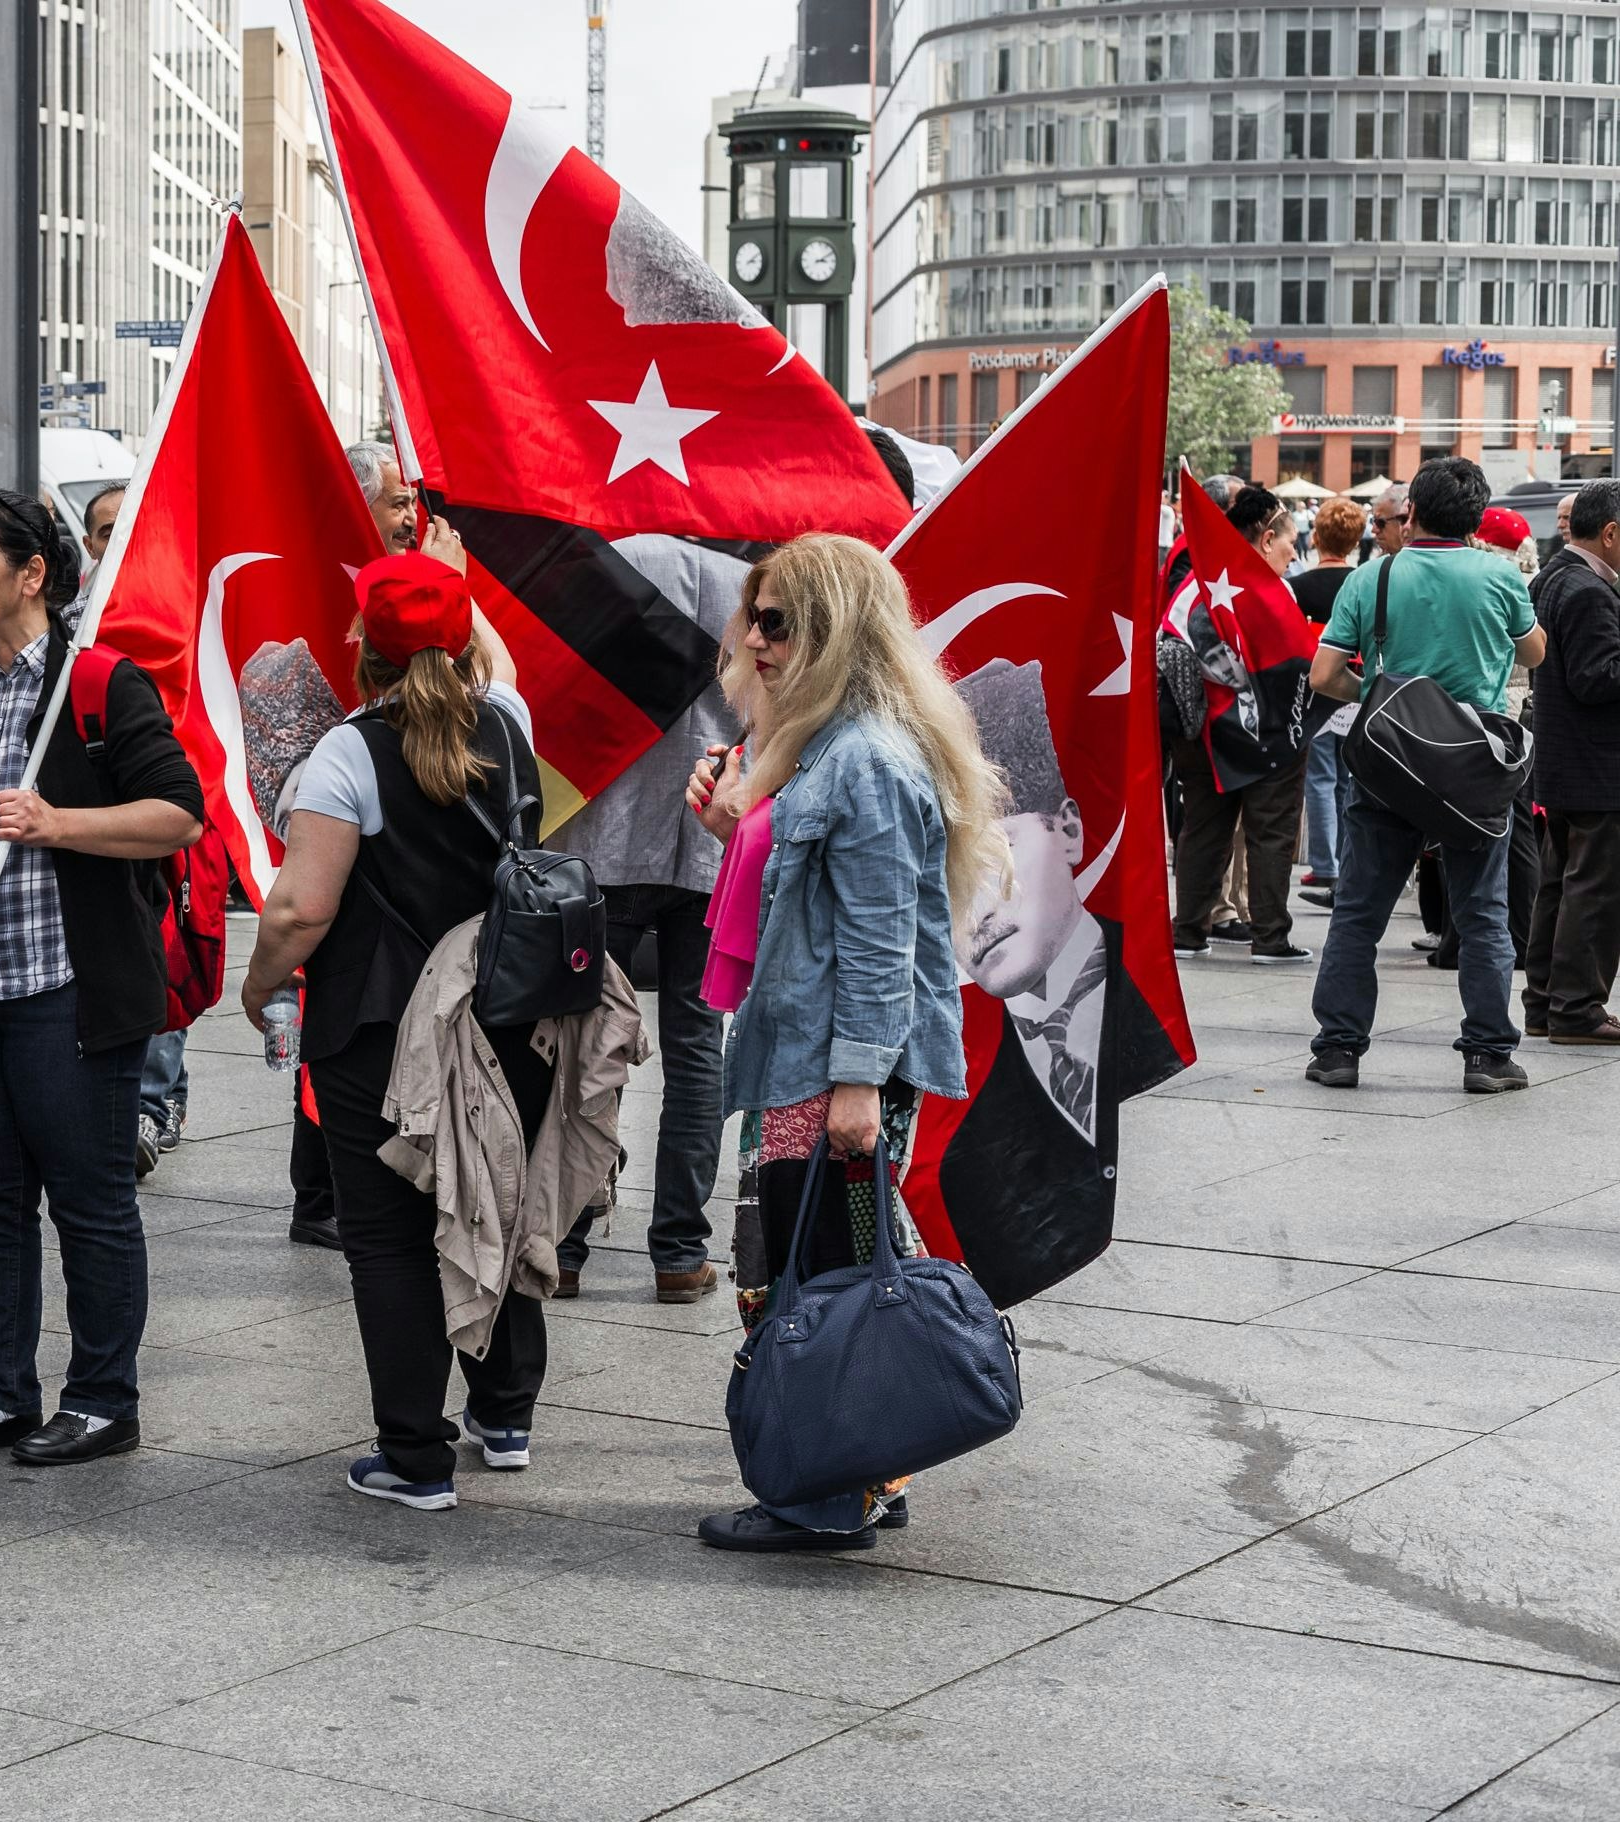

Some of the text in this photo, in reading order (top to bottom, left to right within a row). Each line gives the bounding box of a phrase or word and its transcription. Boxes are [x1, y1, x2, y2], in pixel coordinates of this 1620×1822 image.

[968, 348, 1040, 369] Potsdamer
[1228, 344, 1306, 367] Regus
[1443, 343, 1506, 370] Regus
[1296, 414, 1397, 431] HypoVereinsbank
